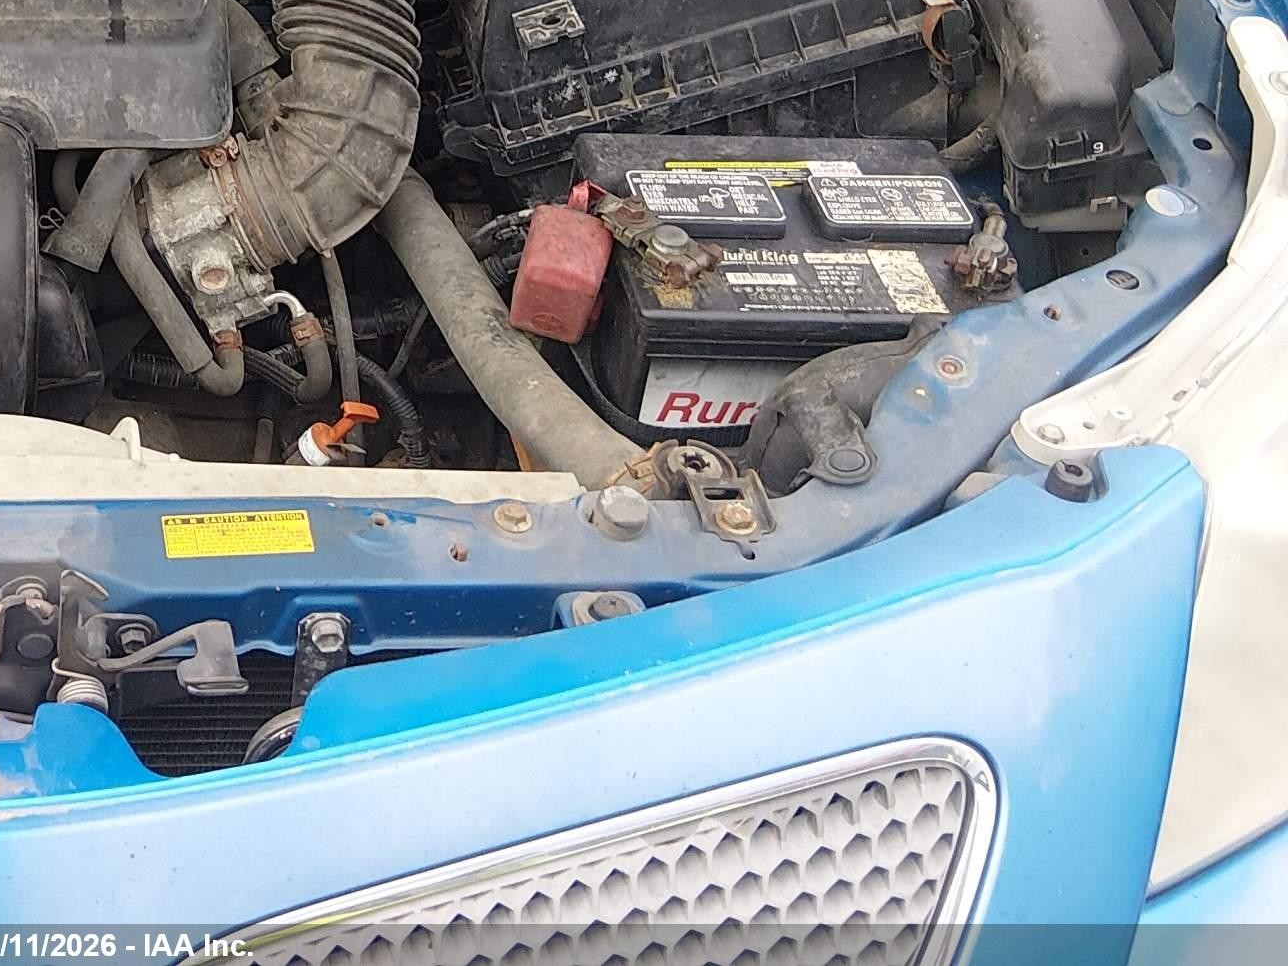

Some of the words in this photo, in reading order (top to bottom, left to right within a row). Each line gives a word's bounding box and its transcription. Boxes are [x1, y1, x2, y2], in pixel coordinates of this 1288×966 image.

[639, 184, 666, 192] FLUSH
[839, 180, 943, 188] DANGER/POISON
[732, 193, 768, 201] MEDICAL
[648, 204, 669, 212] WITH
[761, 250, 799, 265] King
[203, 515, 248, 524] CAUTION
[253, 513, 303, 522] ATTENTION
